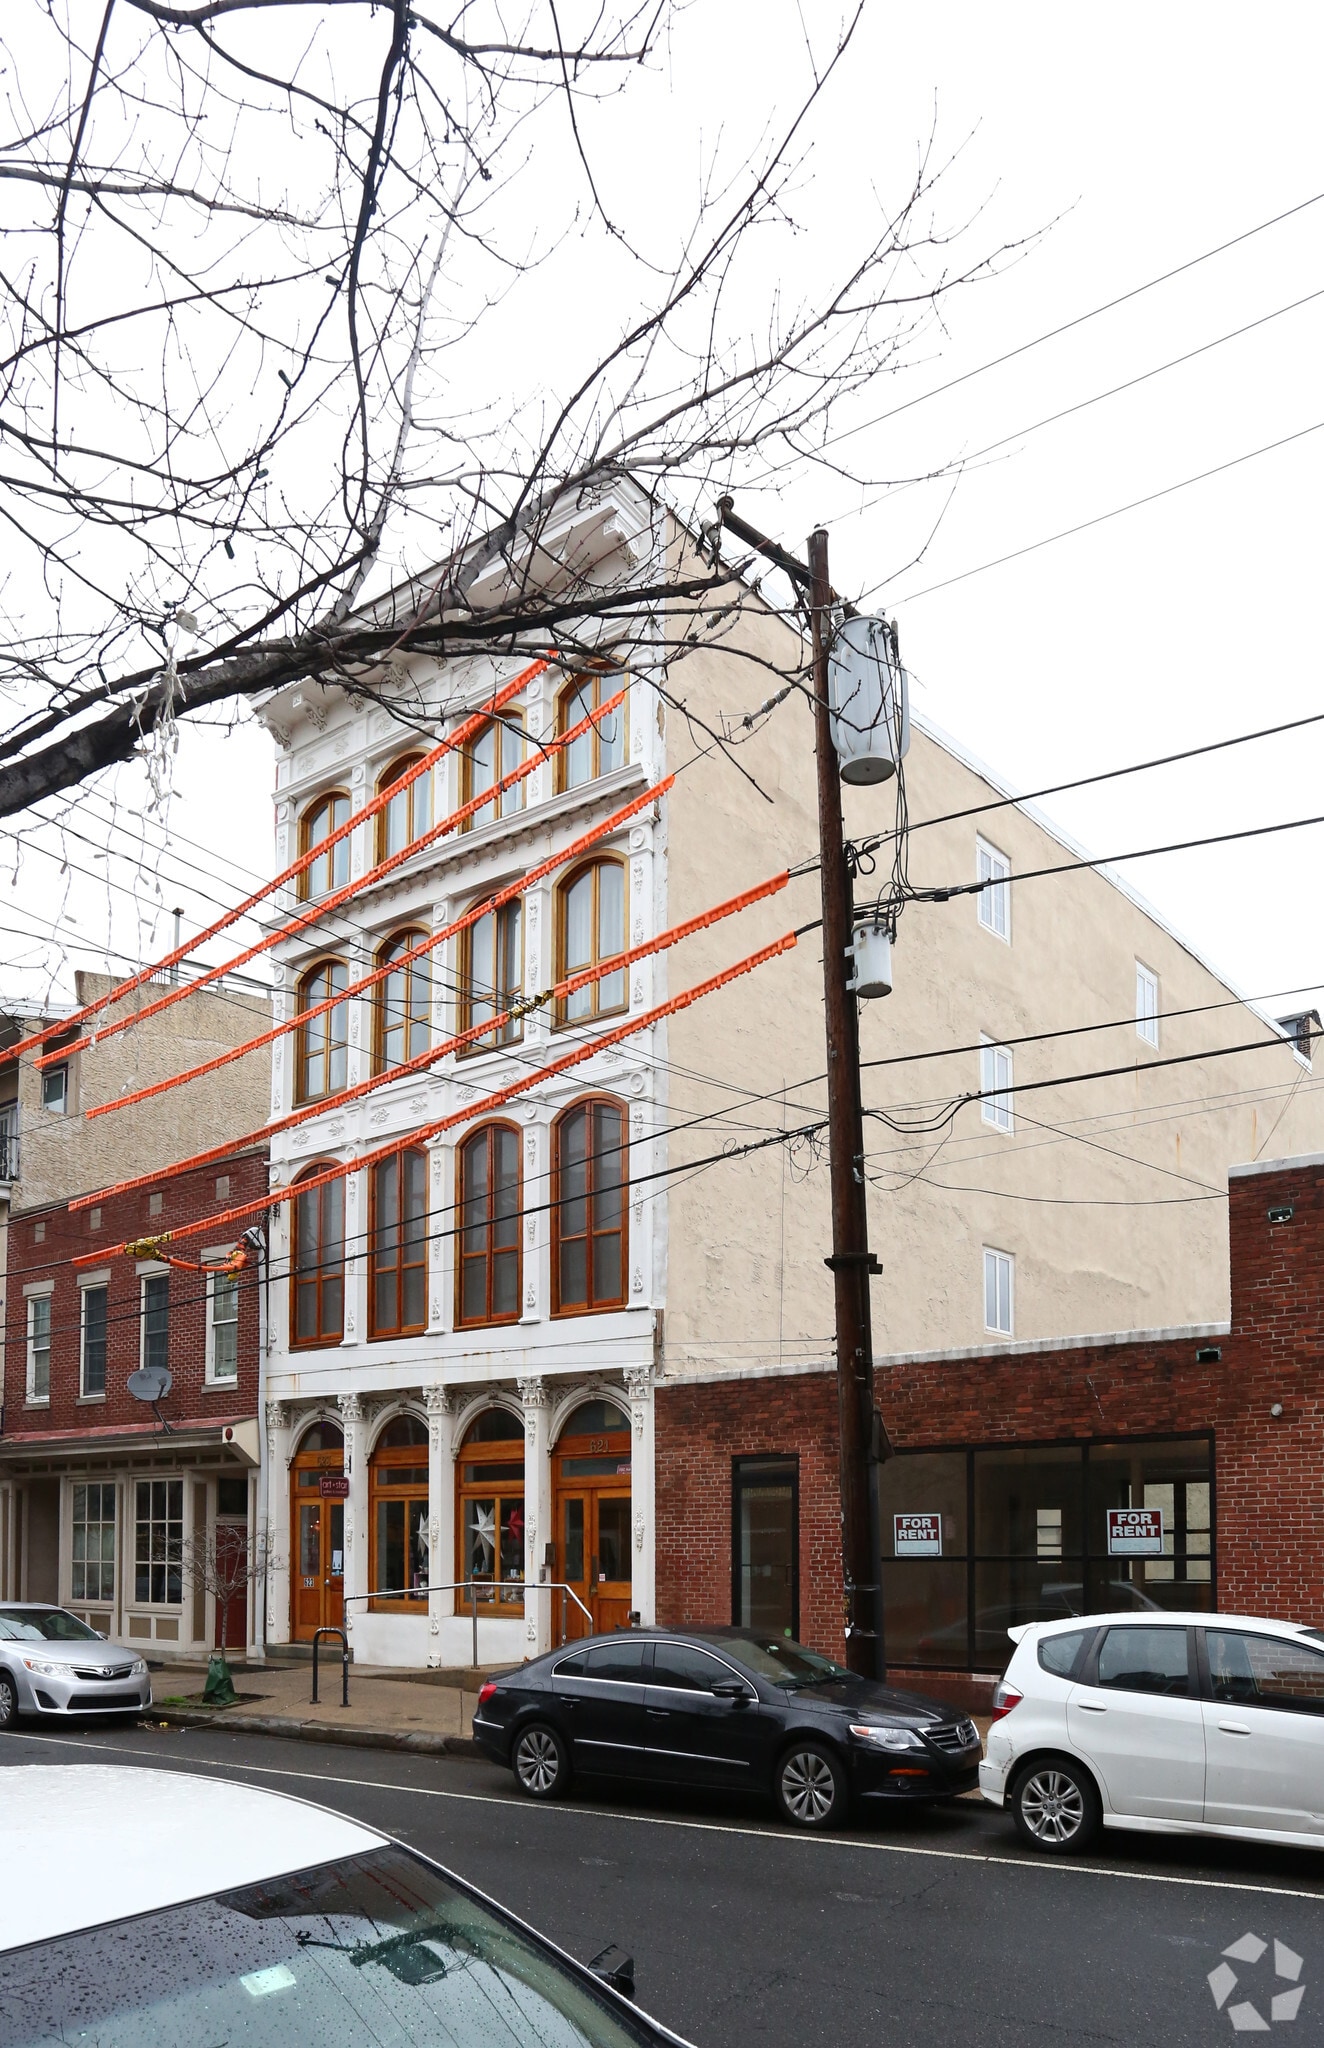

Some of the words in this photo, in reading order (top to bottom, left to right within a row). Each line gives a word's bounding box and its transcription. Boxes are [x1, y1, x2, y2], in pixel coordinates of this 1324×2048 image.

[590, 1440, 609, 1452] 621
[902, 1518, 932, 1528] FOR
[1117, 1513, 1152, 1525] FOR
[898, 1529, 937, 1540] RENT
[1112, 1525, 1158, 1537] RENT
